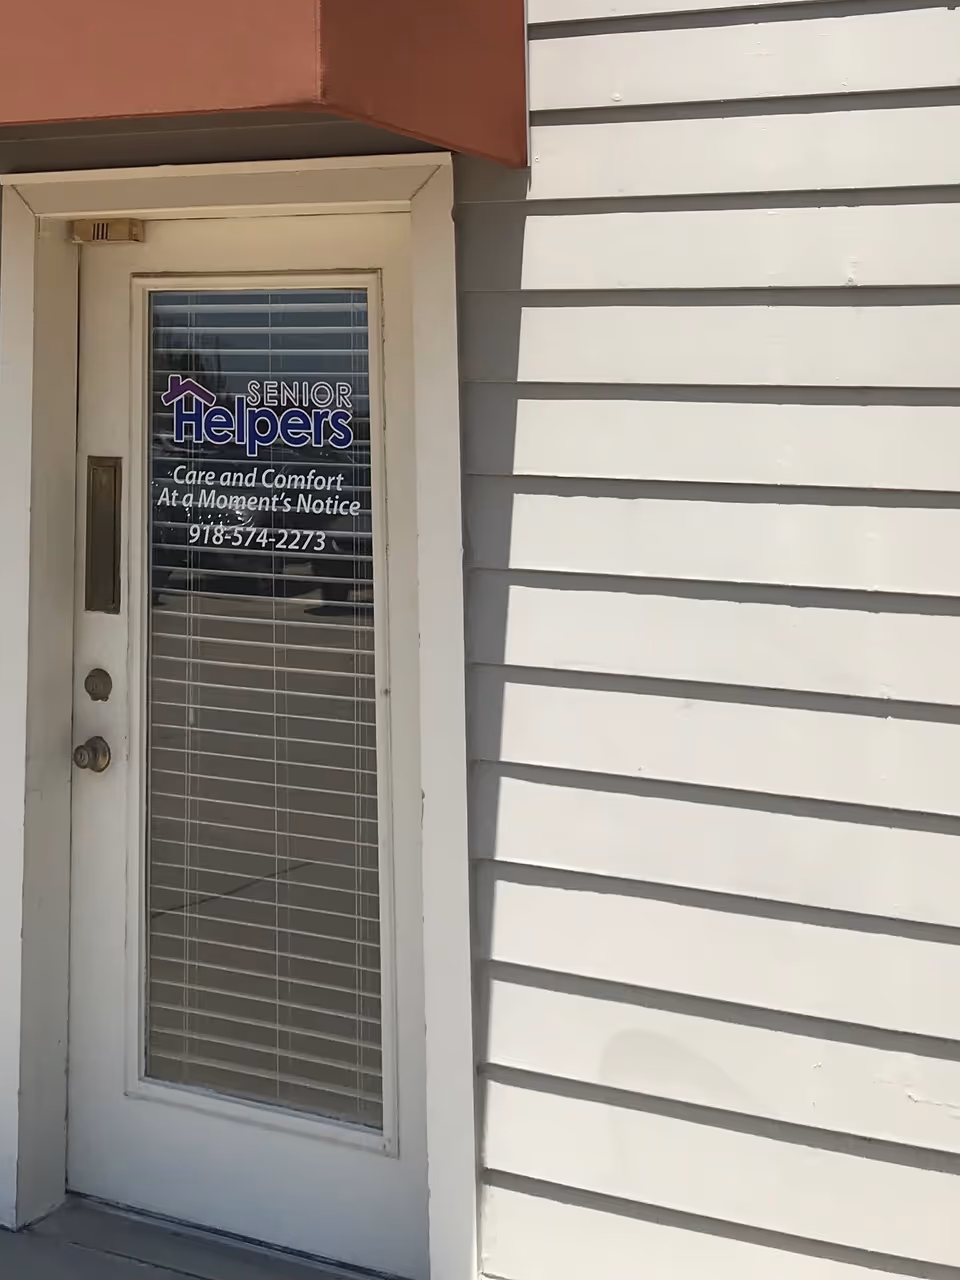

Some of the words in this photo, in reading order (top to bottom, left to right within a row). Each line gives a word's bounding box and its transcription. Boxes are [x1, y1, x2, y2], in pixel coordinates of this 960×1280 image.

[247, 380, 352, 407] SENIOR
[173, 395, 353, 456] Helpers
[173, 465, 216, 486] Care
[220, 468, 257, 488] and
[261, 469, 345, 491] Comfort
[157, 487, 178, 507] At
[182, 492, 194, 508] a
[198, 489, 291, 513] Moment's
[296, 494, 361, 516] Notice
[189, 524, 326, 551] 918-574-2273
